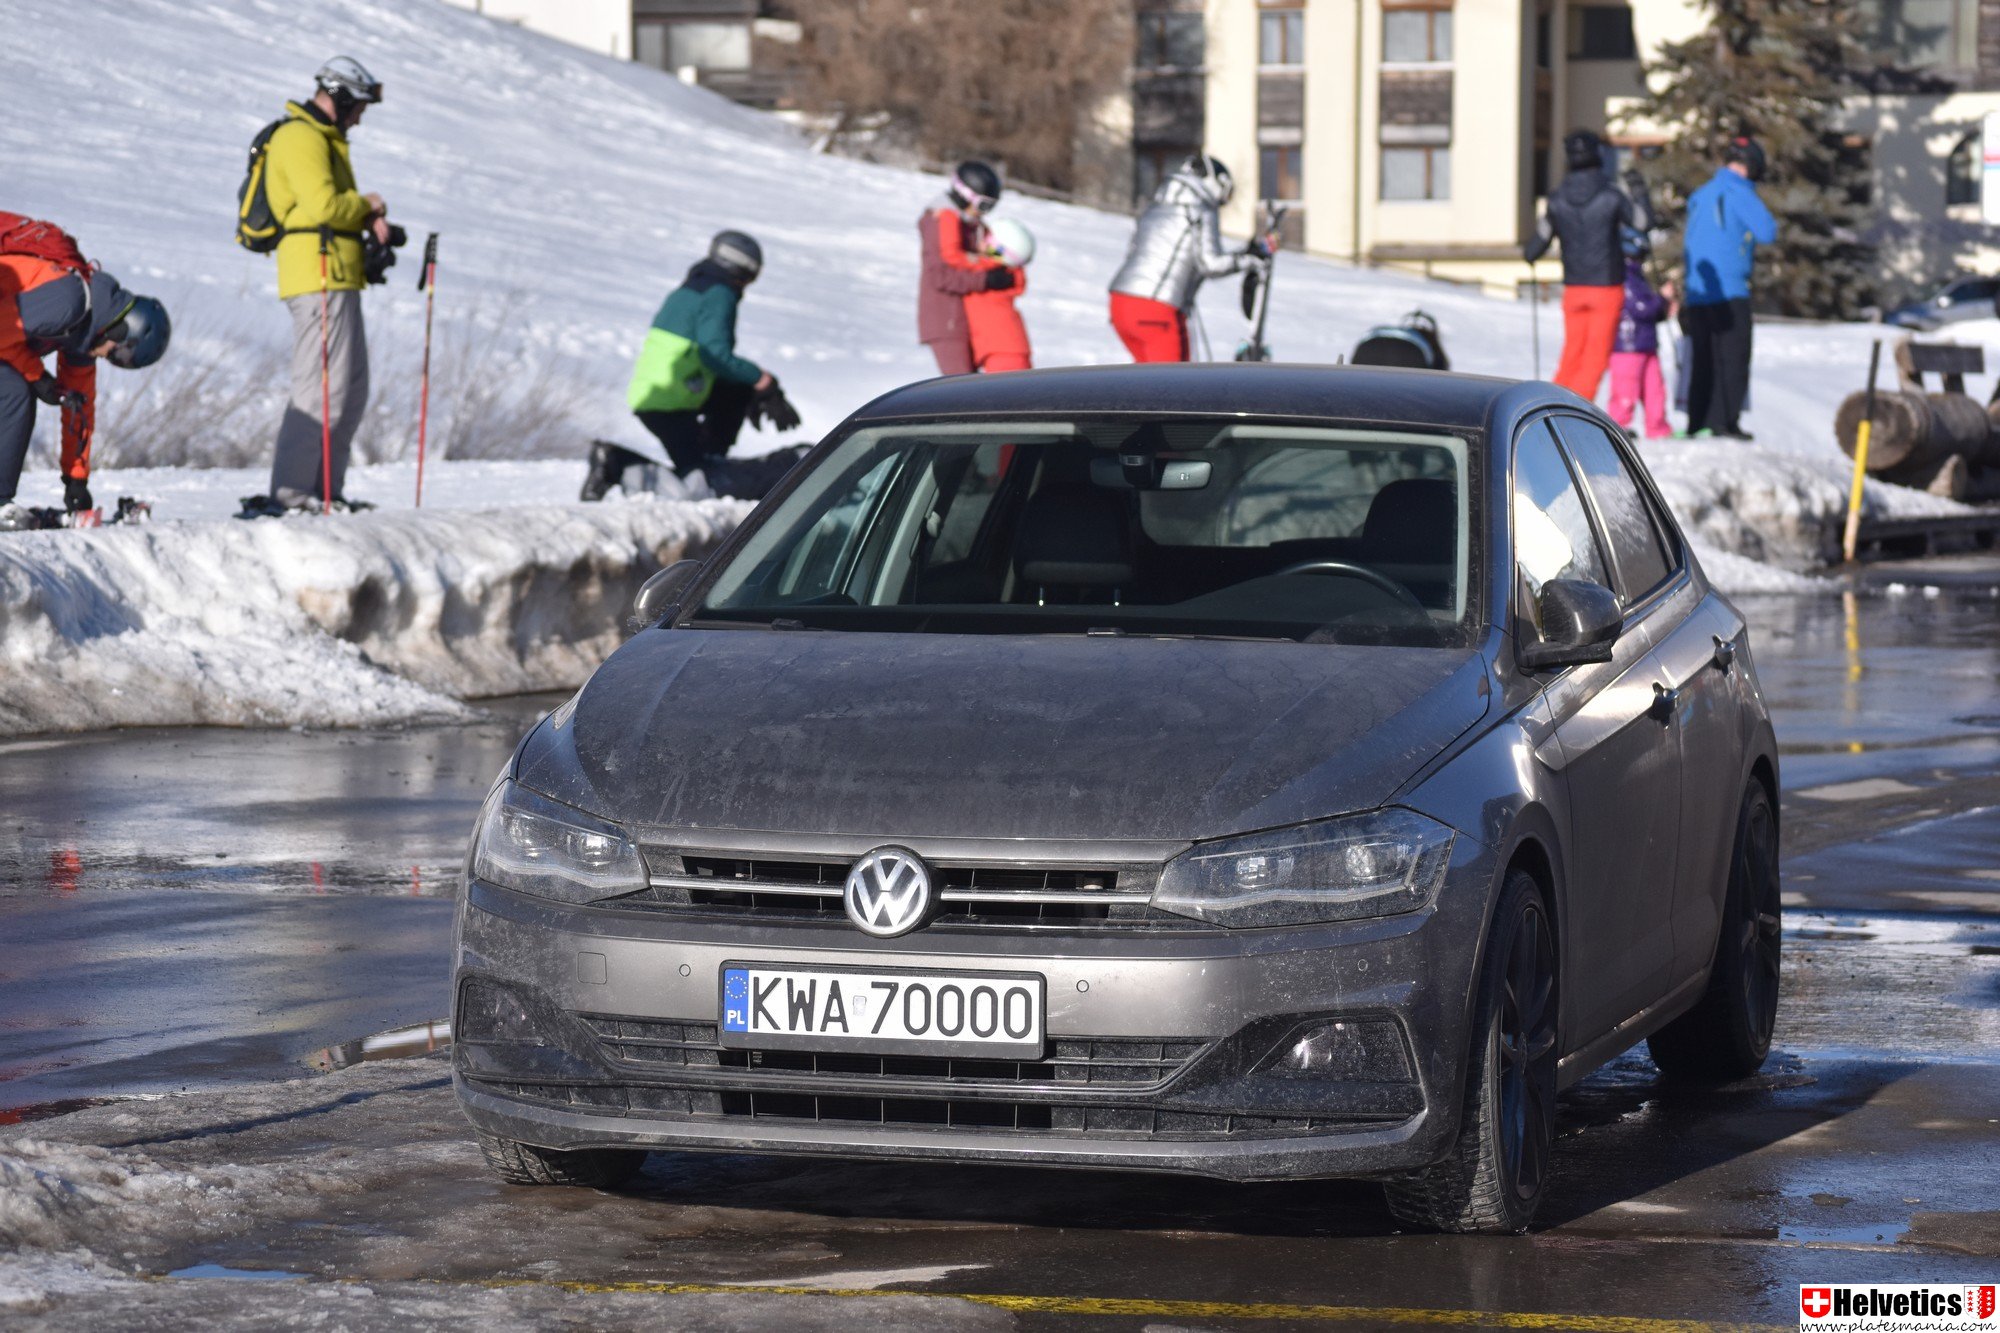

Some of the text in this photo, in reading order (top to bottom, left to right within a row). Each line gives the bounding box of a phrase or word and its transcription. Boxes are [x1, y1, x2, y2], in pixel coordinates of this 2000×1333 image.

[852, 853, 928, 929] VW
[726, 1009, 745, 1026] PL
[752, 976, 1033, 1039] KWA 70000
